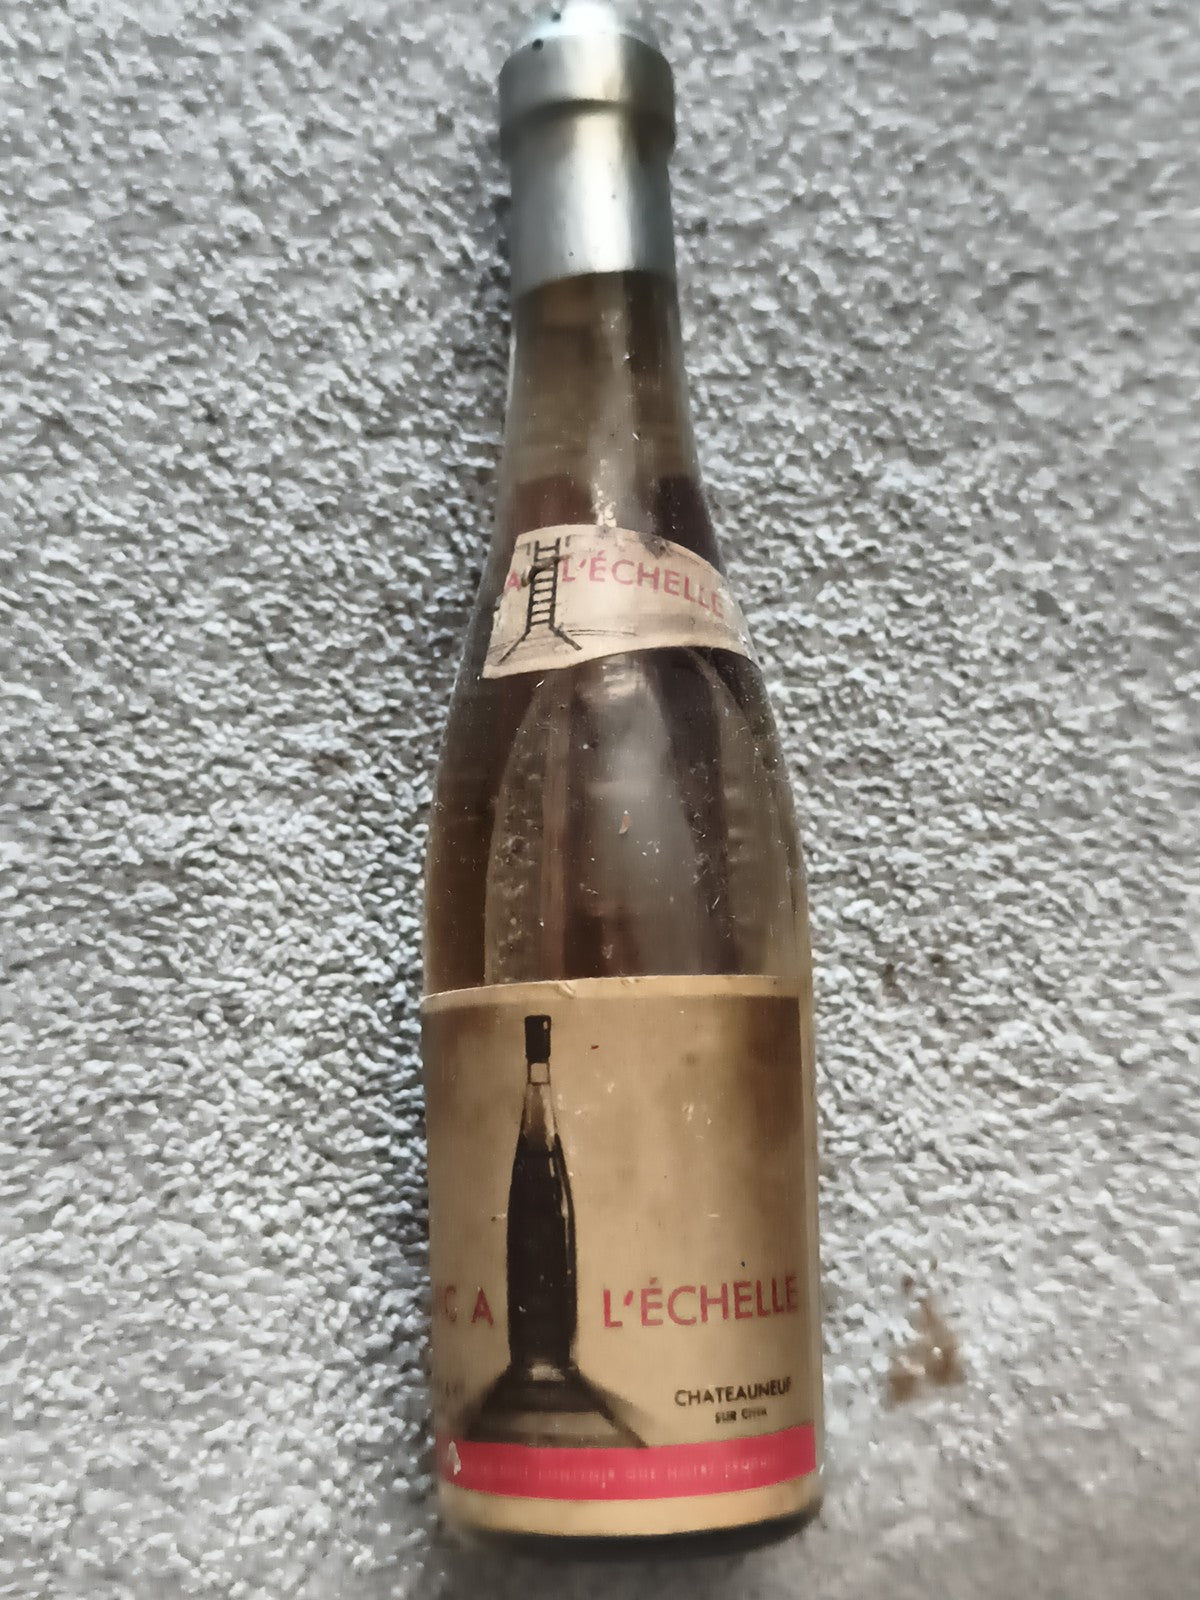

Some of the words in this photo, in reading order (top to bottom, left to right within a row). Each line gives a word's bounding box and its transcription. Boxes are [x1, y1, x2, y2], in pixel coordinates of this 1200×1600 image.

[561, 551, 725, 618] L'ÉCHELLE
[603, 1276, 799, 1328] L'ÉCHELLE
[674, 1376, 792, 1406] CHATEAUNEUF
